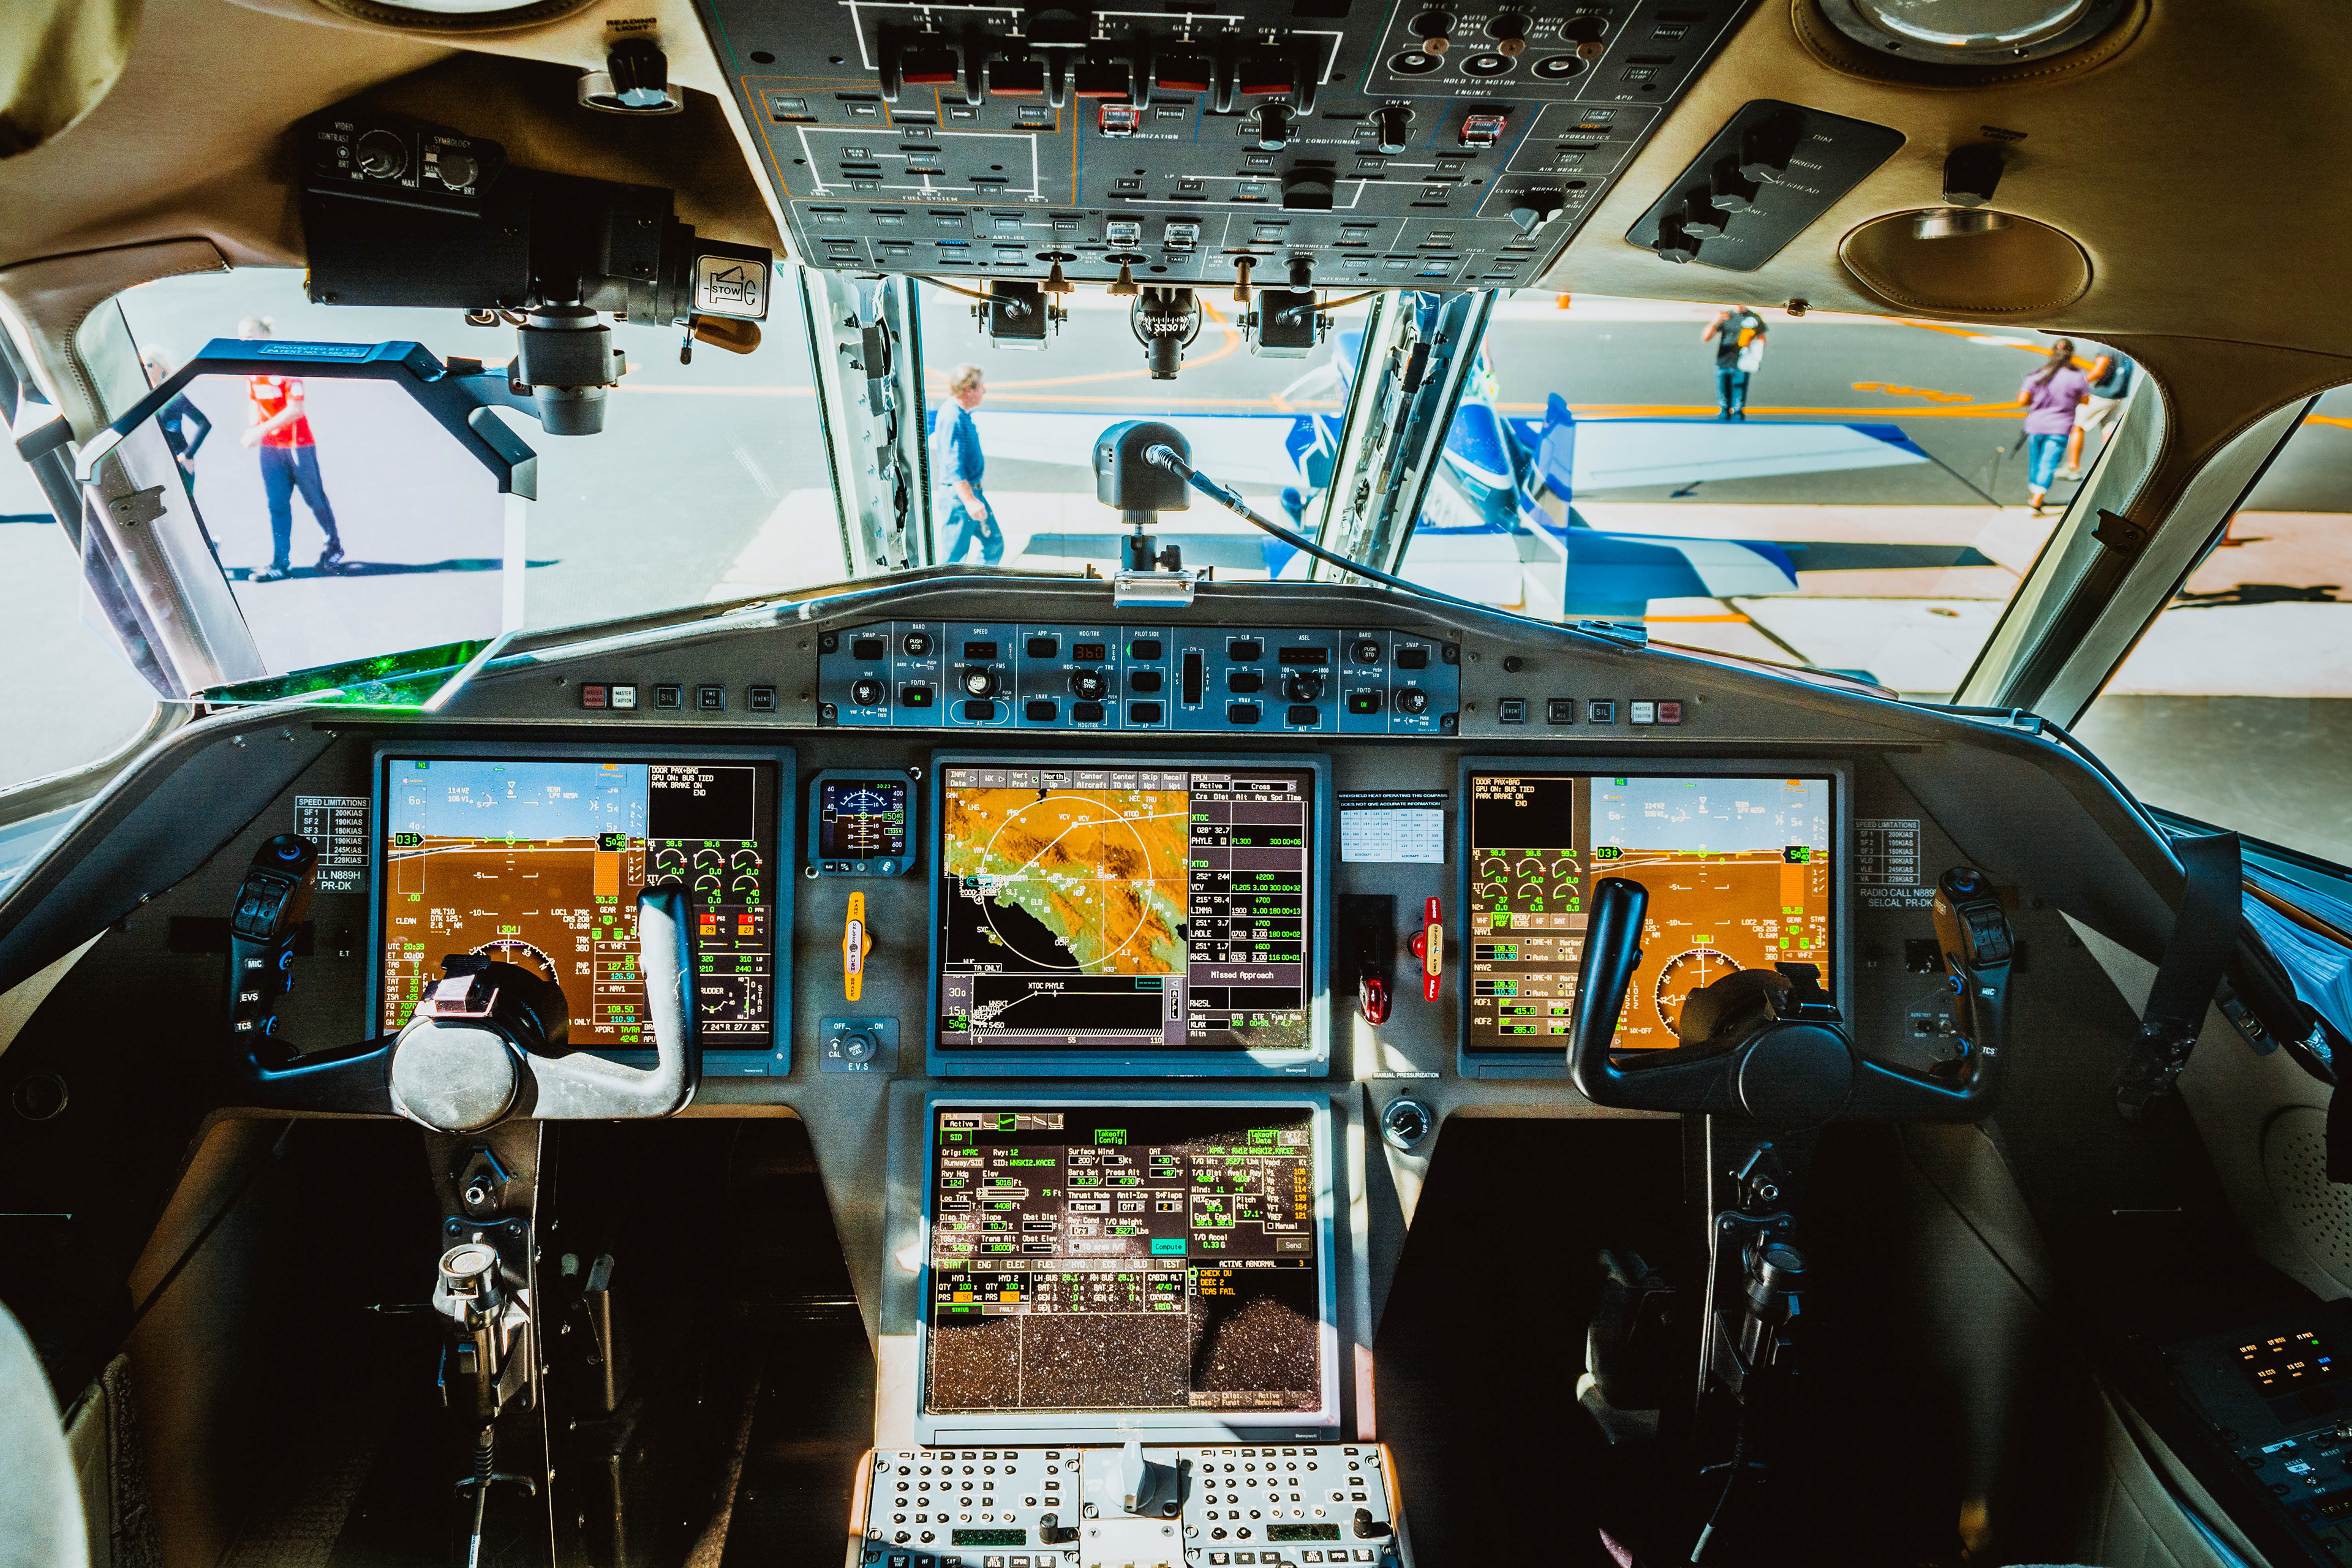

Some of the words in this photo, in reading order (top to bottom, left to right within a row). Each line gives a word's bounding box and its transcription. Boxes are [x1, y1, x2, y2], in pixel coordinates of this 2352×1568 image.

[318, 132, 349, 143] CONTRAST
[434, 137, 471, 148] SYMBOLOGY
[712, 285, 741, 296] STOW
